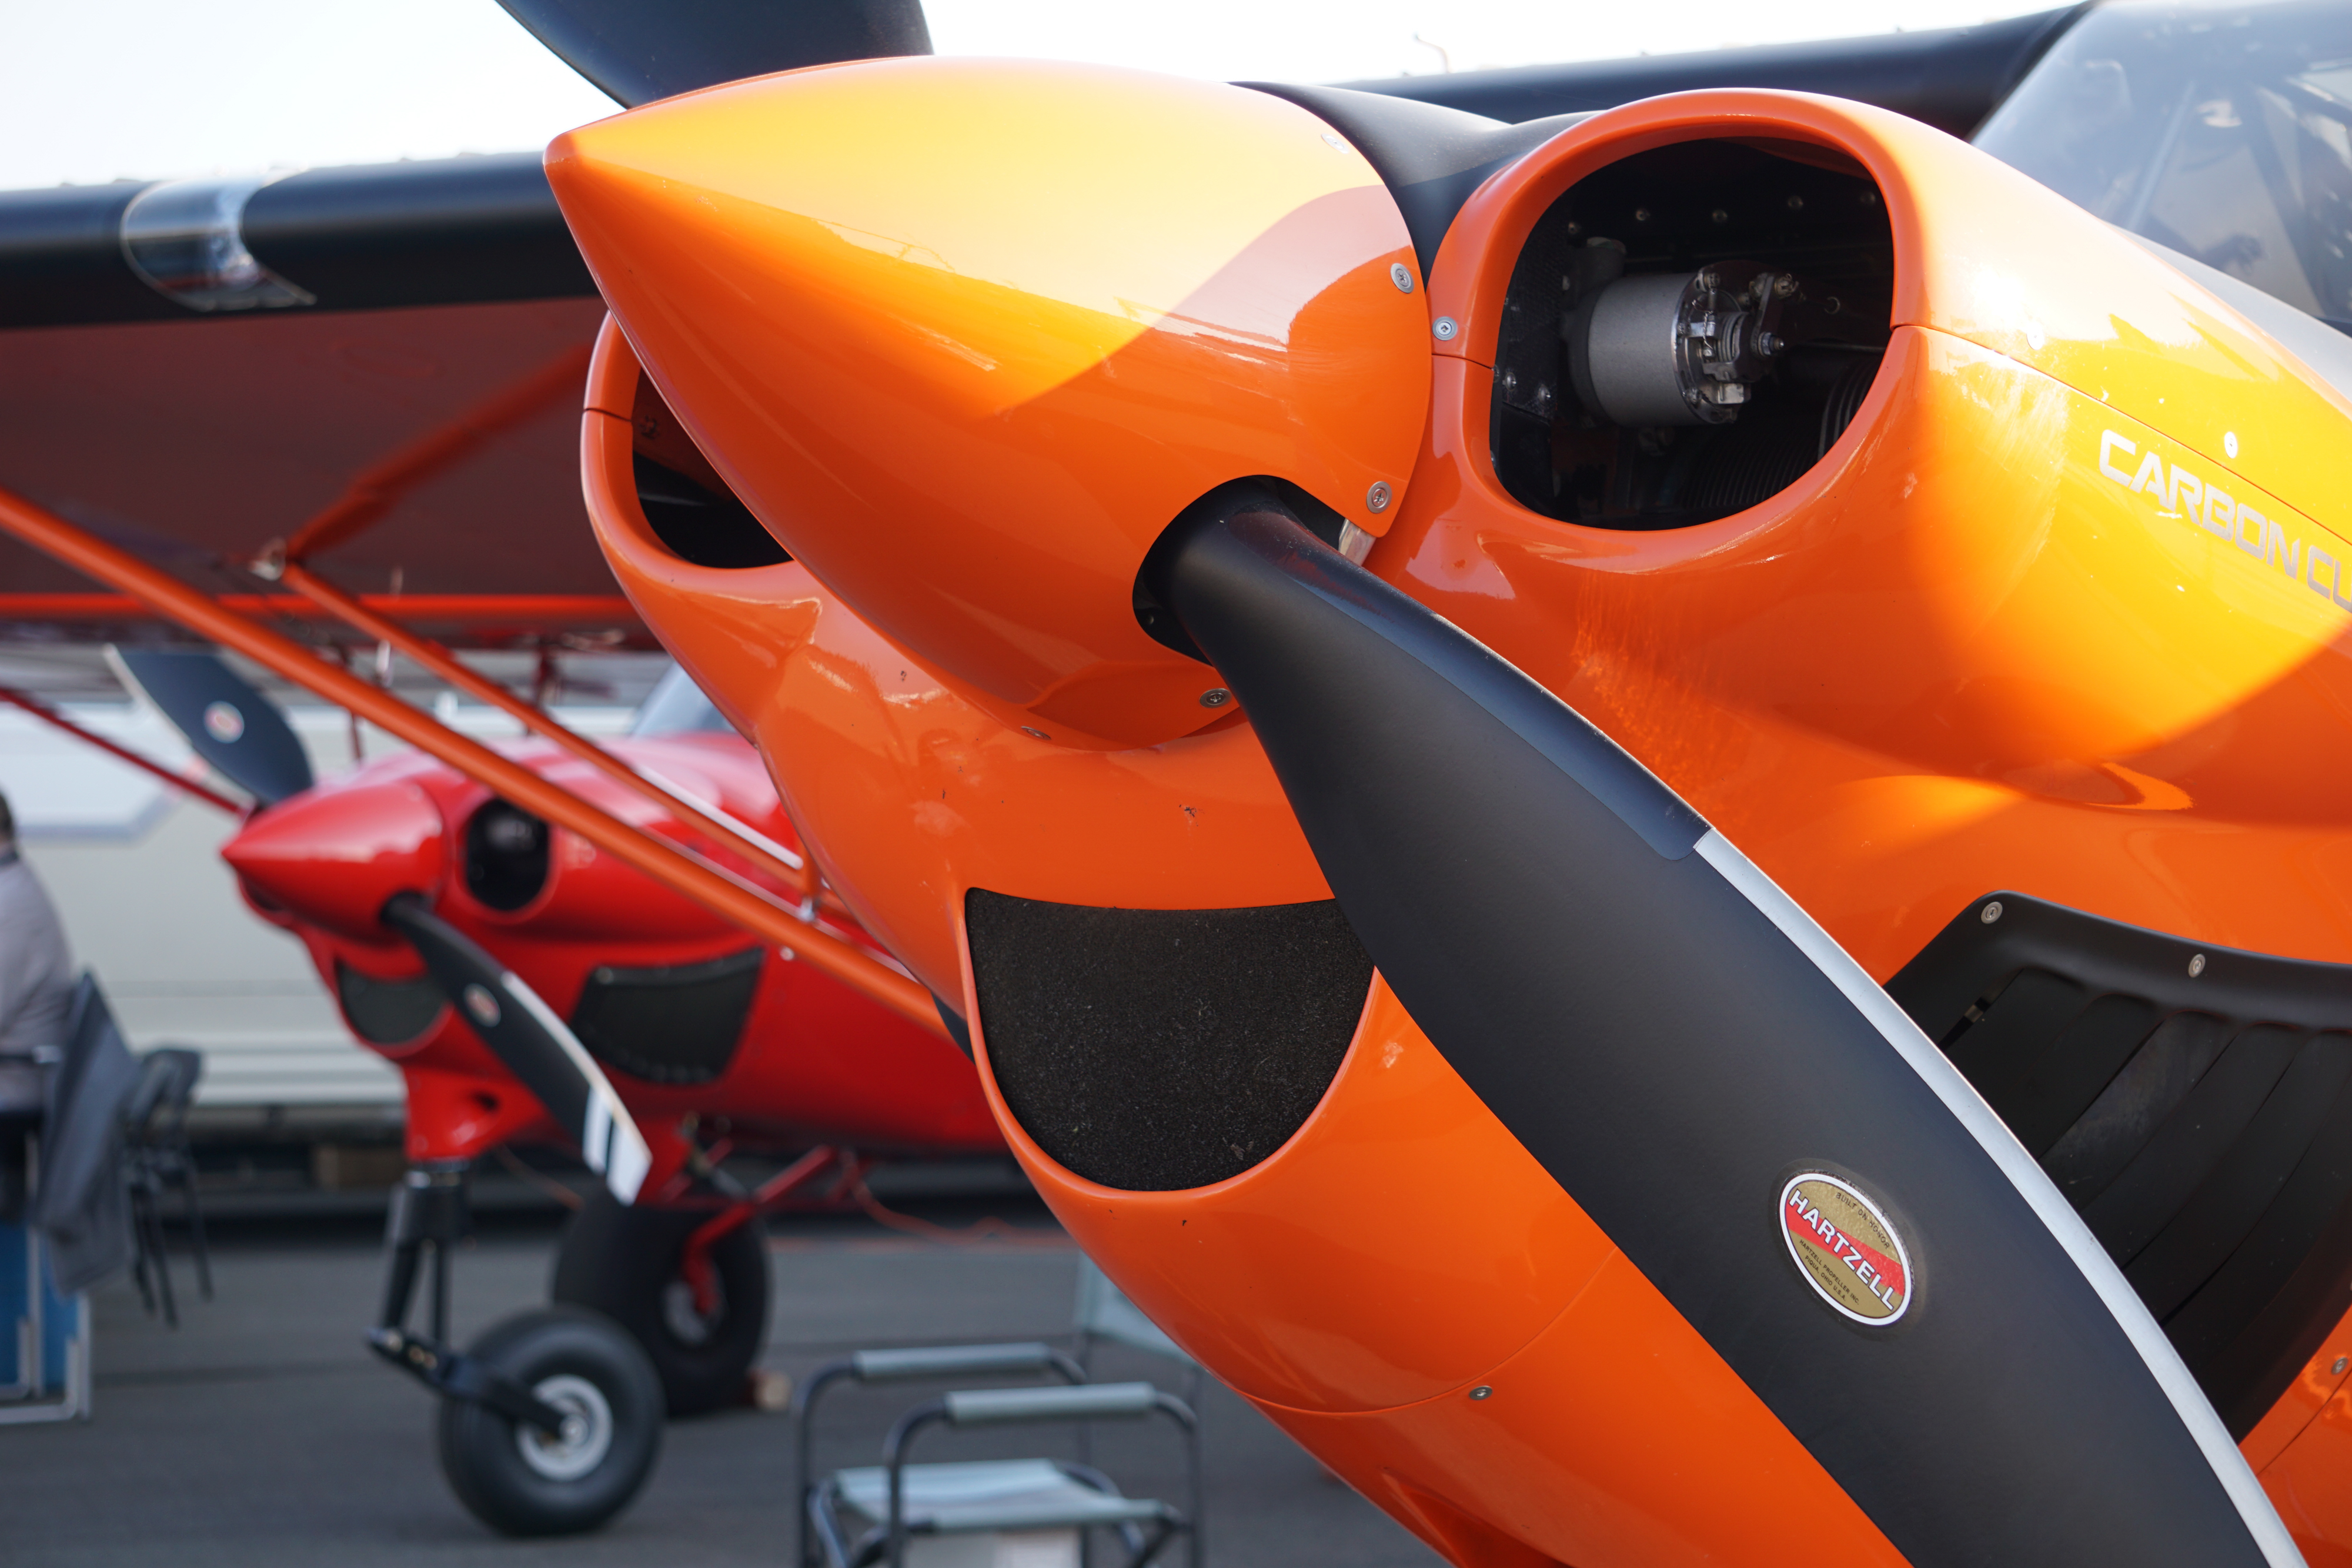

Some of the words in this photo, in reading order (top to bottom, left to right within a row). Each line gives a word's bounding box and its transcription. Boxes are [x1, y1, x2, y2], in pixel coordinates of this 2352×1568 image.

[2099, 429, 2300, 580] CARBON
[1789, 1188, 1895, 1312] HARTZELL
[1835, 1192, 1857, 1208] BUILT
[1858, 1209, 1868, 1221] ON
[1869, 1221, 1890, 1250] HONOR
[1799, 1239, 1822, 1265] HARTZELL
[1823, 1264, 1850, 1293] PROPELLER
[1850, 1293, 1860, 1305] INC.
[1805, 1255, 1819, 1273] PIQUA,
[1821, 1272, 1833, 1286] OHIO
[1833, 1285, 1846, 1301] U.S.A.
